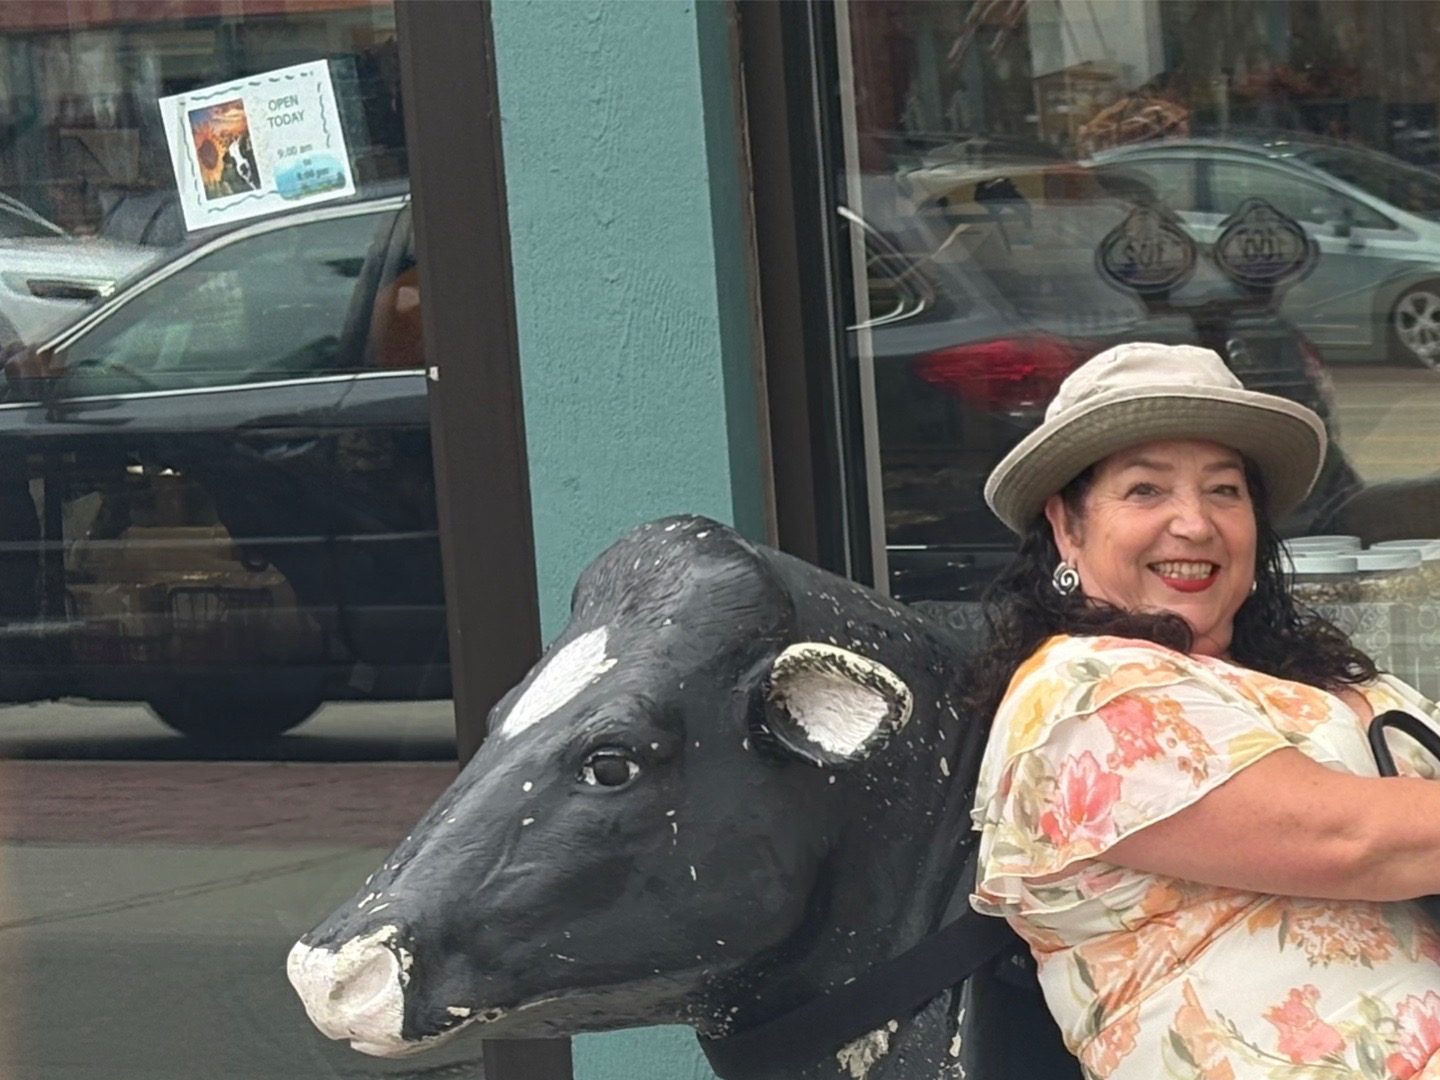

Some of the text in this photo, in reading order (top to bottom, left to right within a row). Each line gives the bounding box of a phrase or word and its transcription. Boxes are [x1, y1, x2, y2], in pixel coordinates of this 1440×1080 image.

[268, 95, 299, 111] OPEN
[267, 109, 304, 128] TODAY
[300, 144, 312, 153] am
